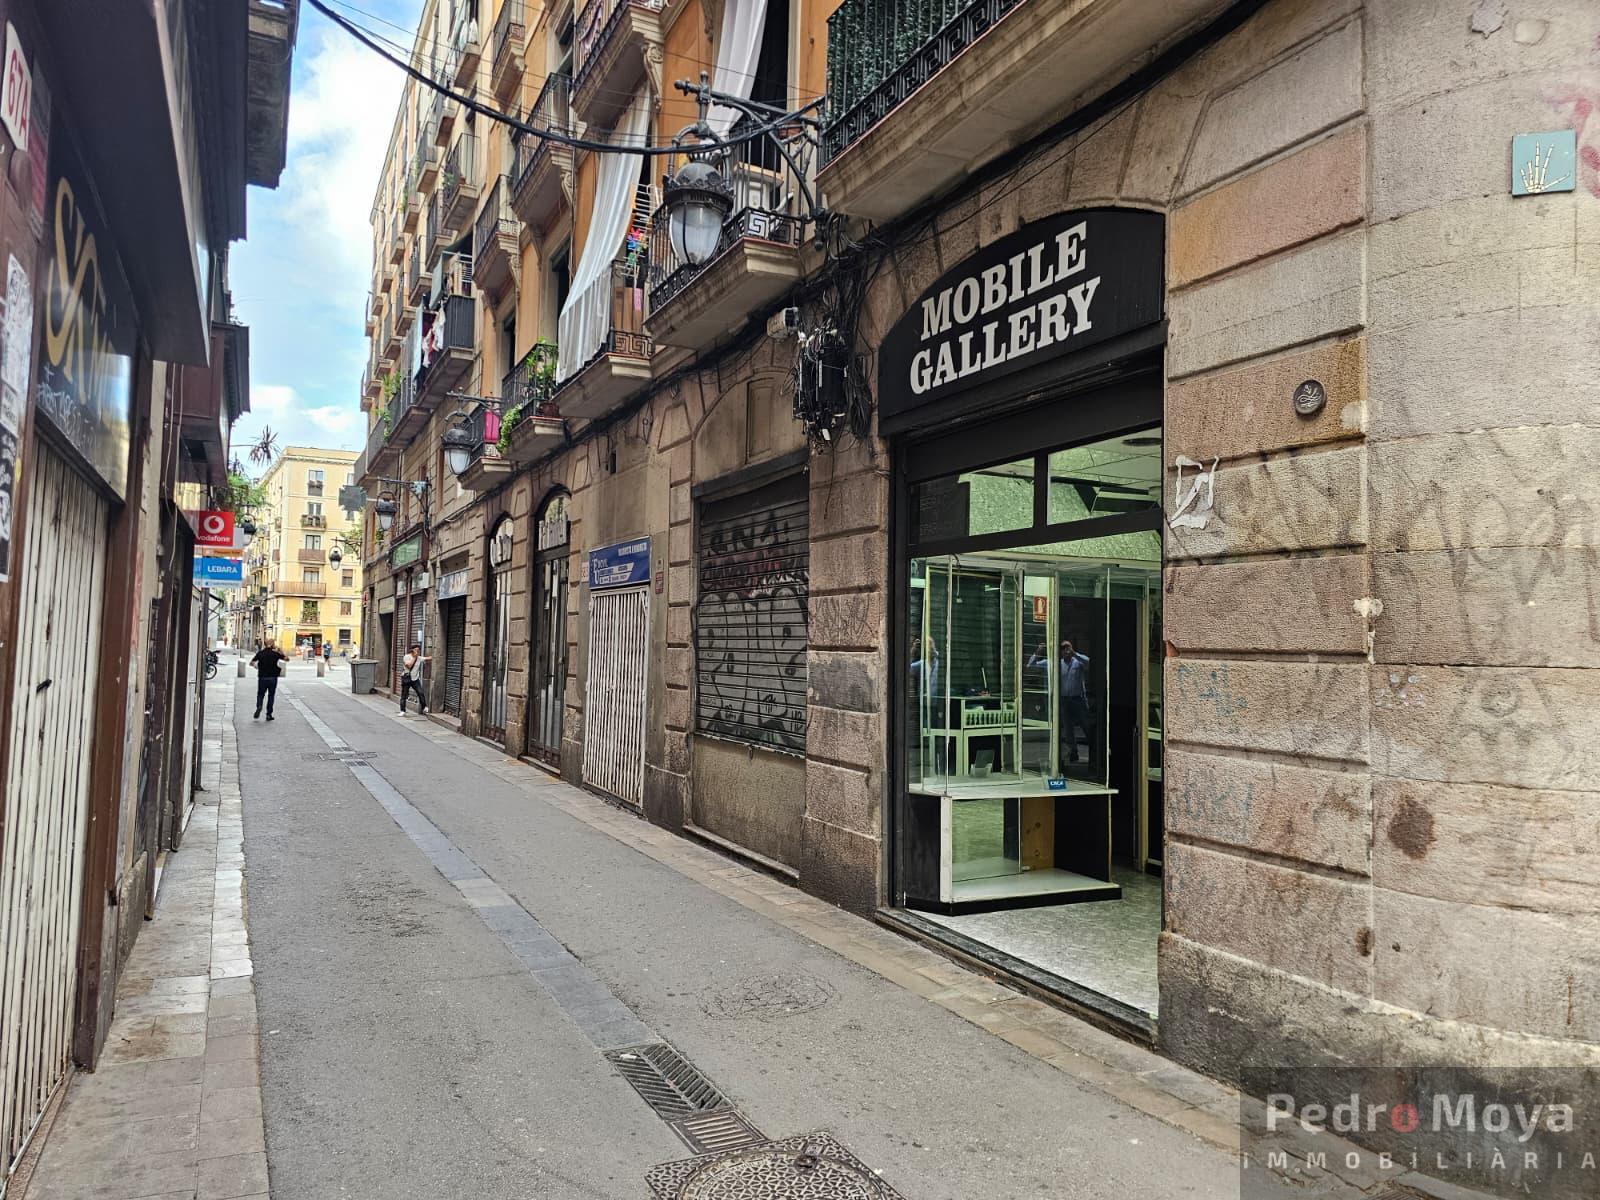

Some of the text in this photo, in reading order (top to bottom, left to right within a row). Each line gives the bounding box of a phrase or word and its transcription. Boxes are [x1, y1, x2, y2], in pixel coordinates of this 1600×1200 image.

[8, 49, 29, 147] 67A
[920, 221, 1087, 341] MOBILE
[910, 276, 1101, 395] GALLERY
[207, 565, 238, 574] LEBARA
